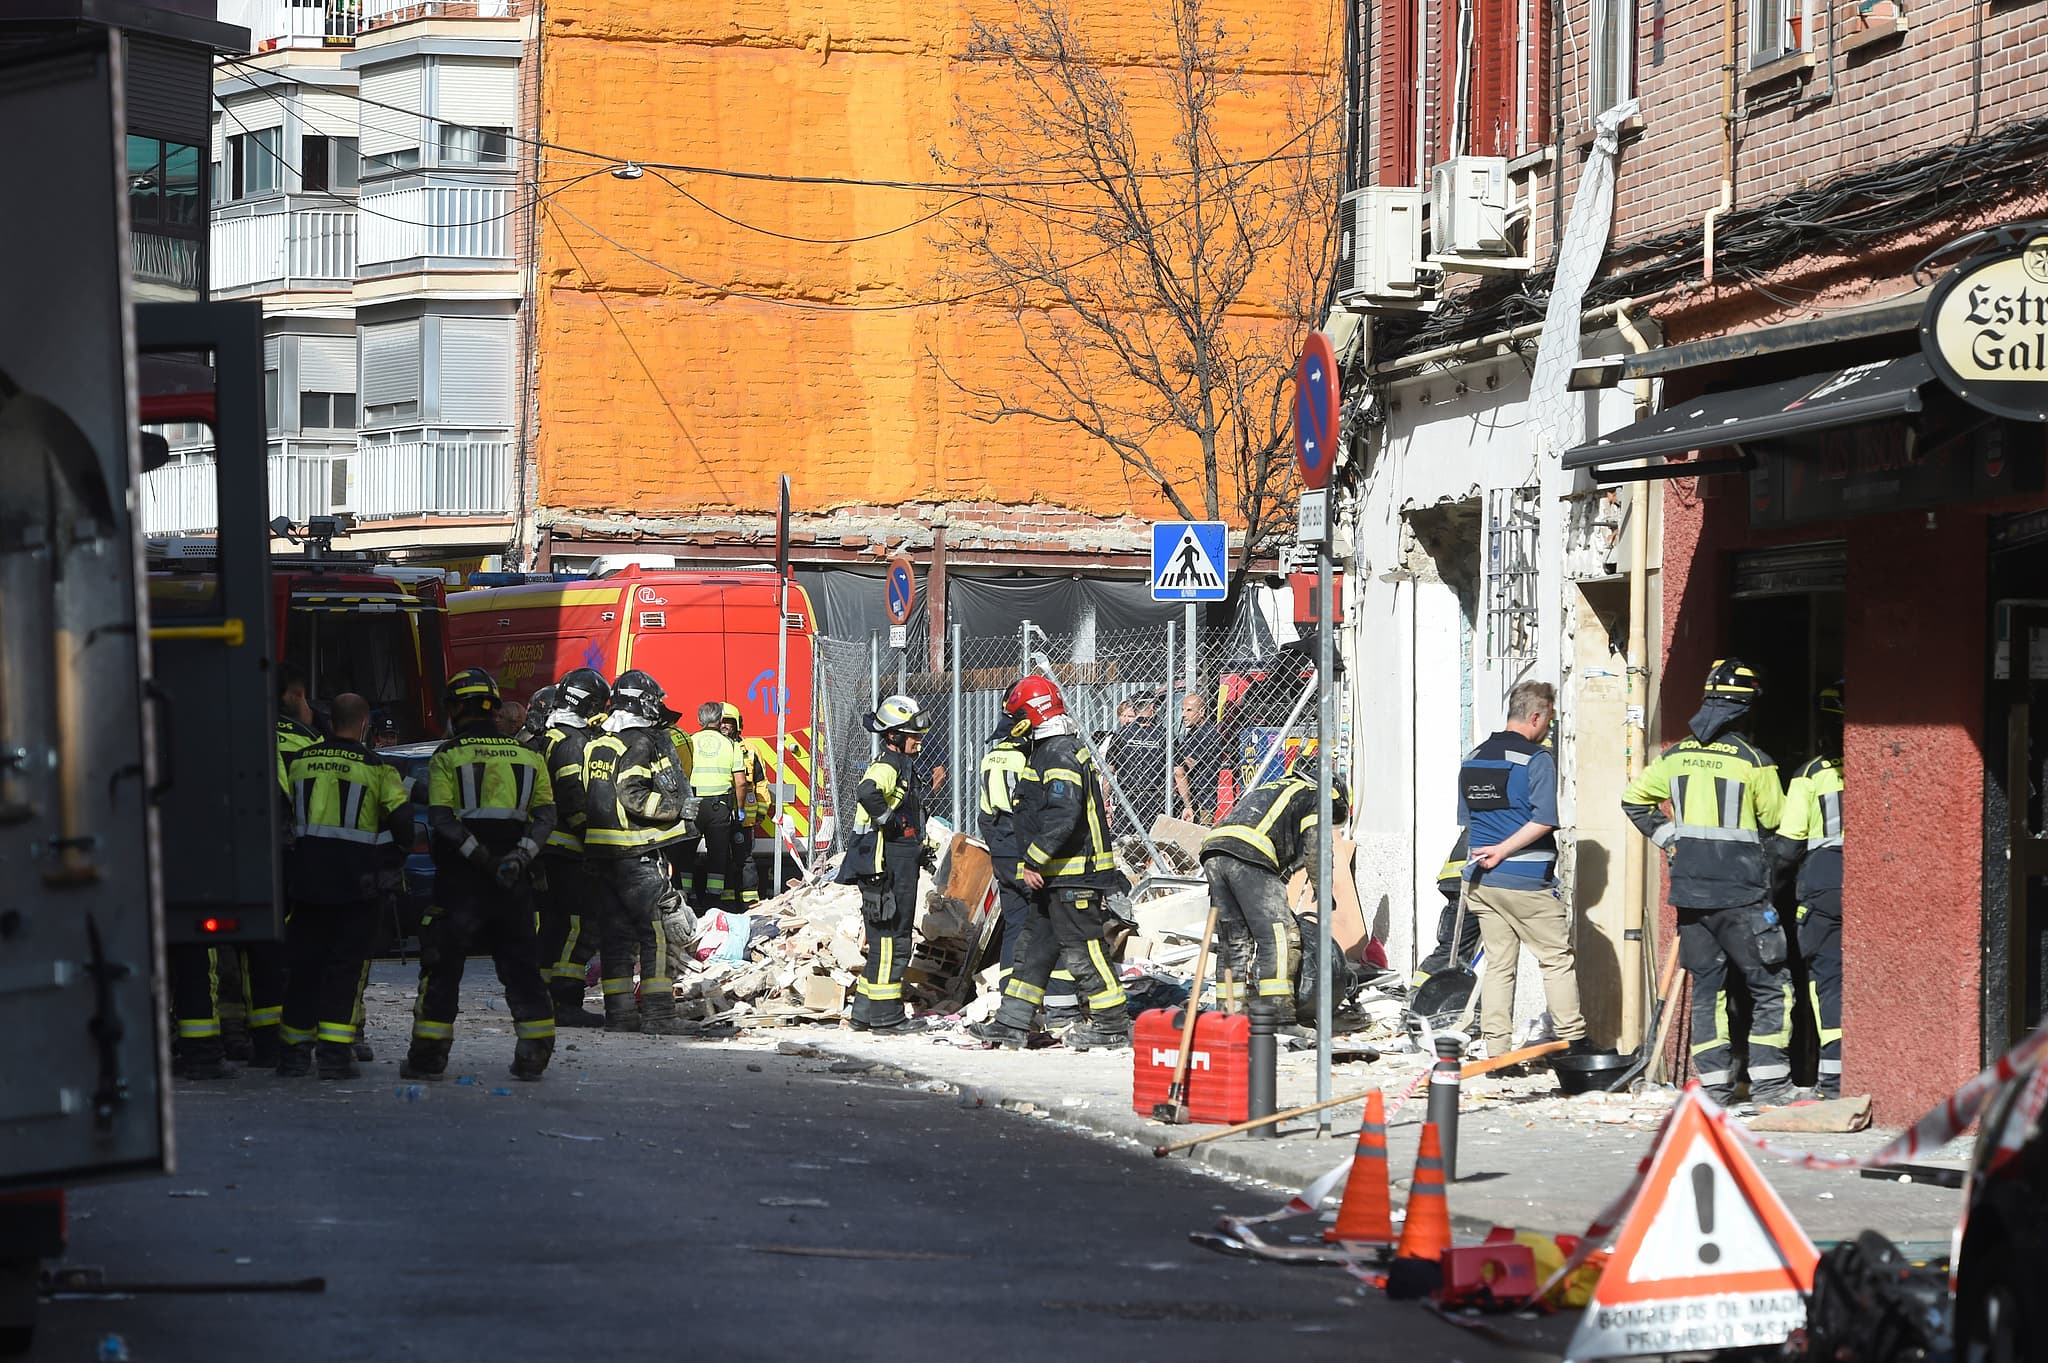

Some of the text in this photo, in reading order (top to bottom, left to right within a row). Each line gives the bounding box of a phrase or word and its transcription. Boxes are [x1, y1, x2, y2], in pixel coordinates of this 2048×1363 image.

[1972, 329, 2048, 371] Gal
[503, 644, 545, 662] BOMBEROS
[508, 662, 536, 680] MADRID
[460, 737, 520, 746] BOMBEROS
[1679, 740, 1739, 755] BOMEROS
[302, 748, 365, 761] BOMBEROS
[474, 749, 518, 758] MADRID
[307, 762, 351, 774] MADRID
[1682, 758, 1724, 770] MADRID
[1152, 1047, 1211, 1071] HITI
[1599, 1302, 1708, 1330] BOMBEROS
[1717, 1300, 1739, 1320] DE
